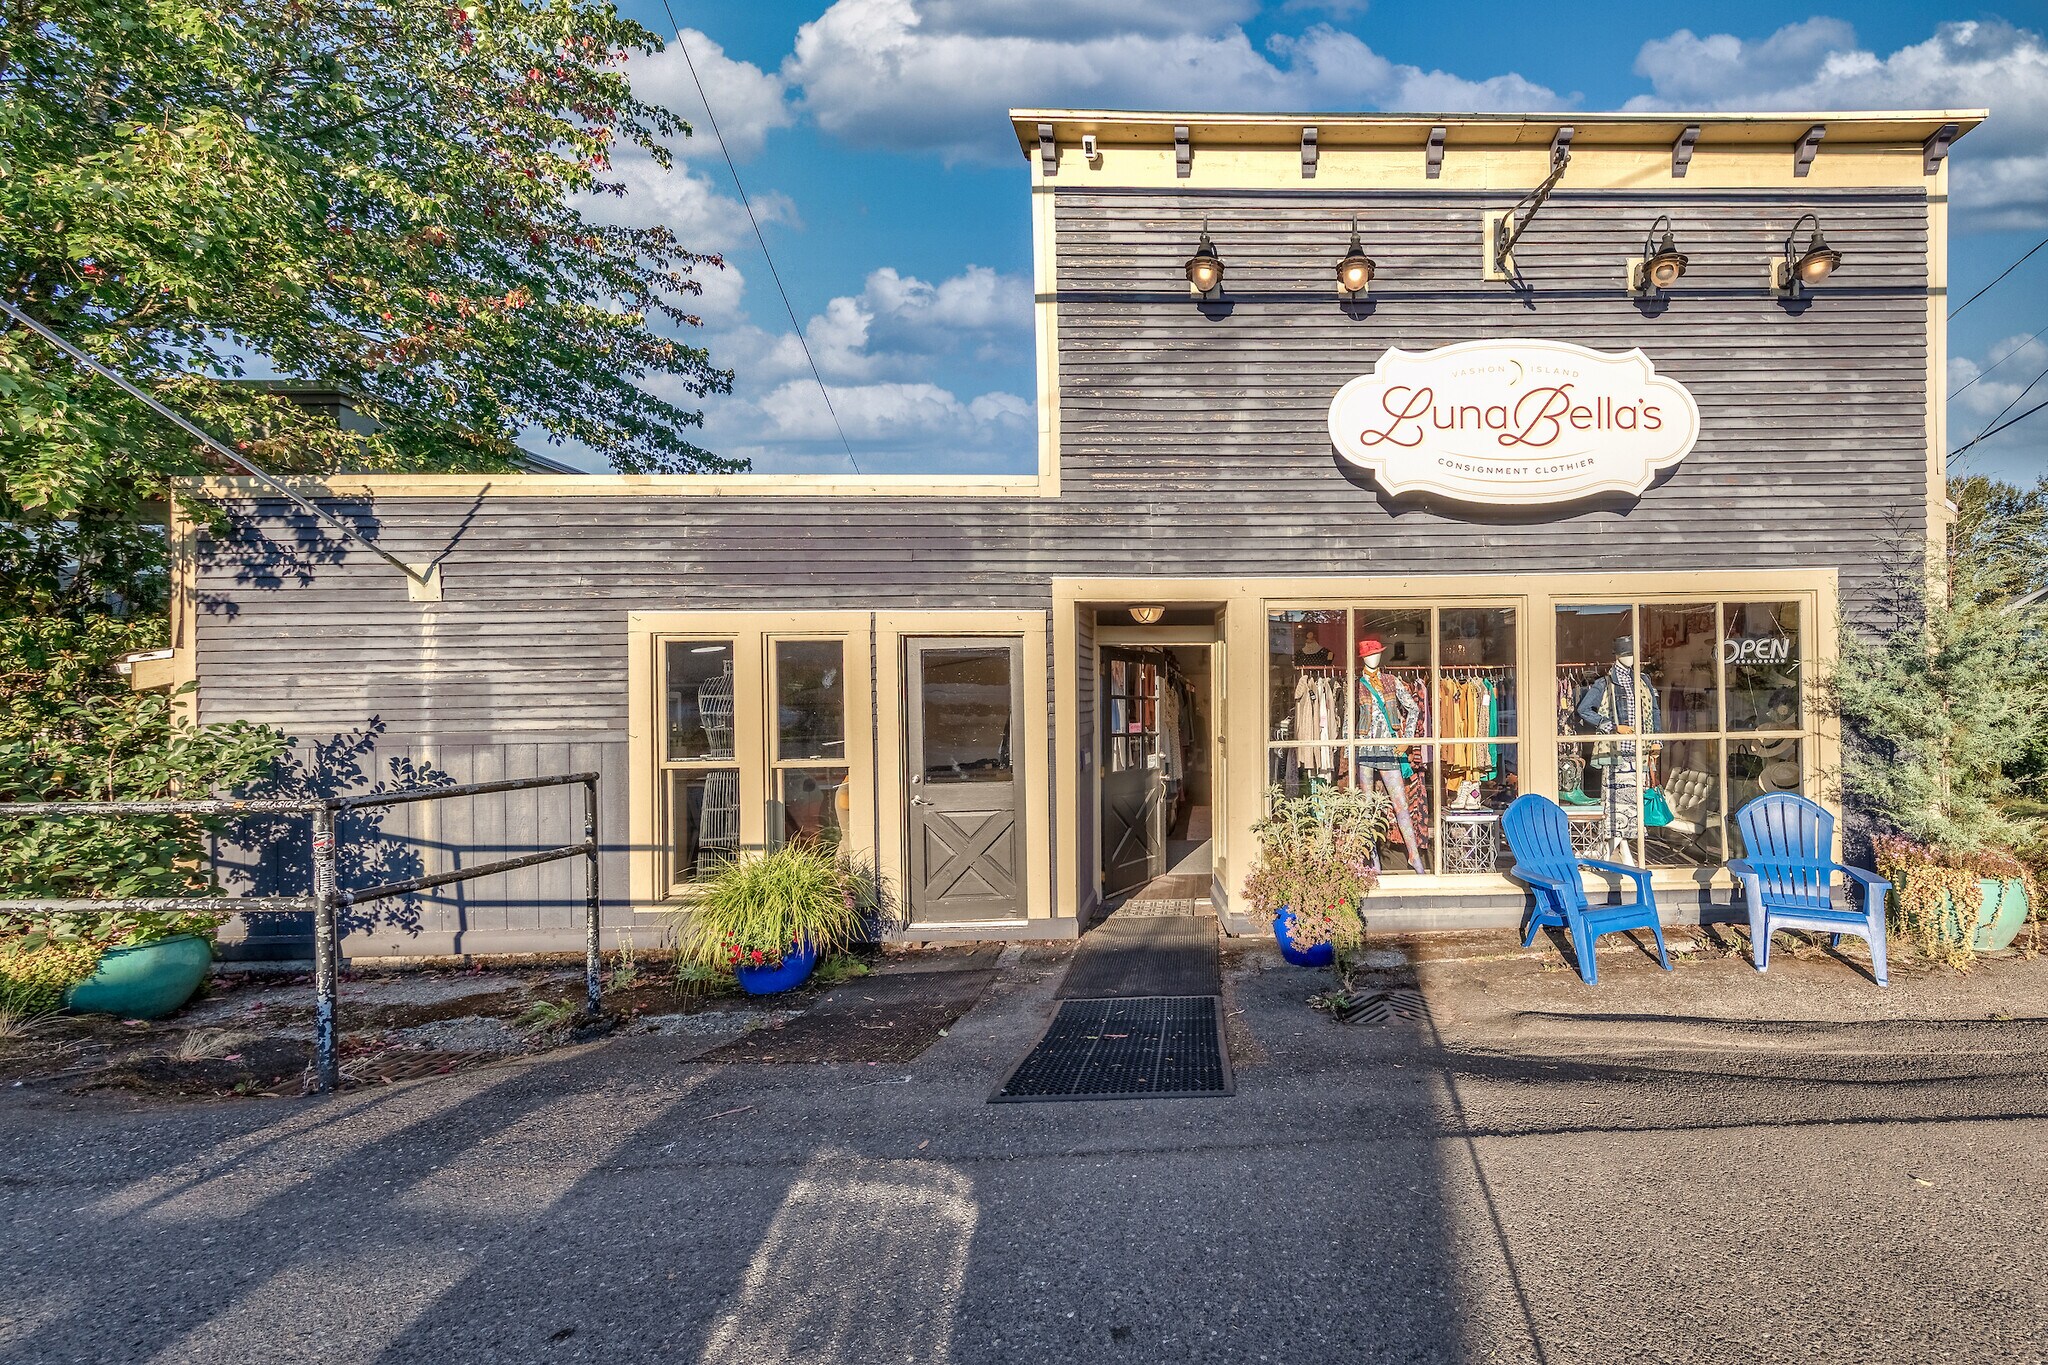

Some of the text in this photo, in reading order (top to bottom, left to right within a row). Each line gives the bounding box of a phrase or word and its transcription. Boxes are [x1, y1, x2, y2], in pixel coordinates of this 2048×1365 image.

[1451, 365, 1579, 378] VASHON ISLAND
[1437, 457, 1596, 475] CONSIGNMENT CLOTHIER
[1714, 637, 1790, 664] OPEN
